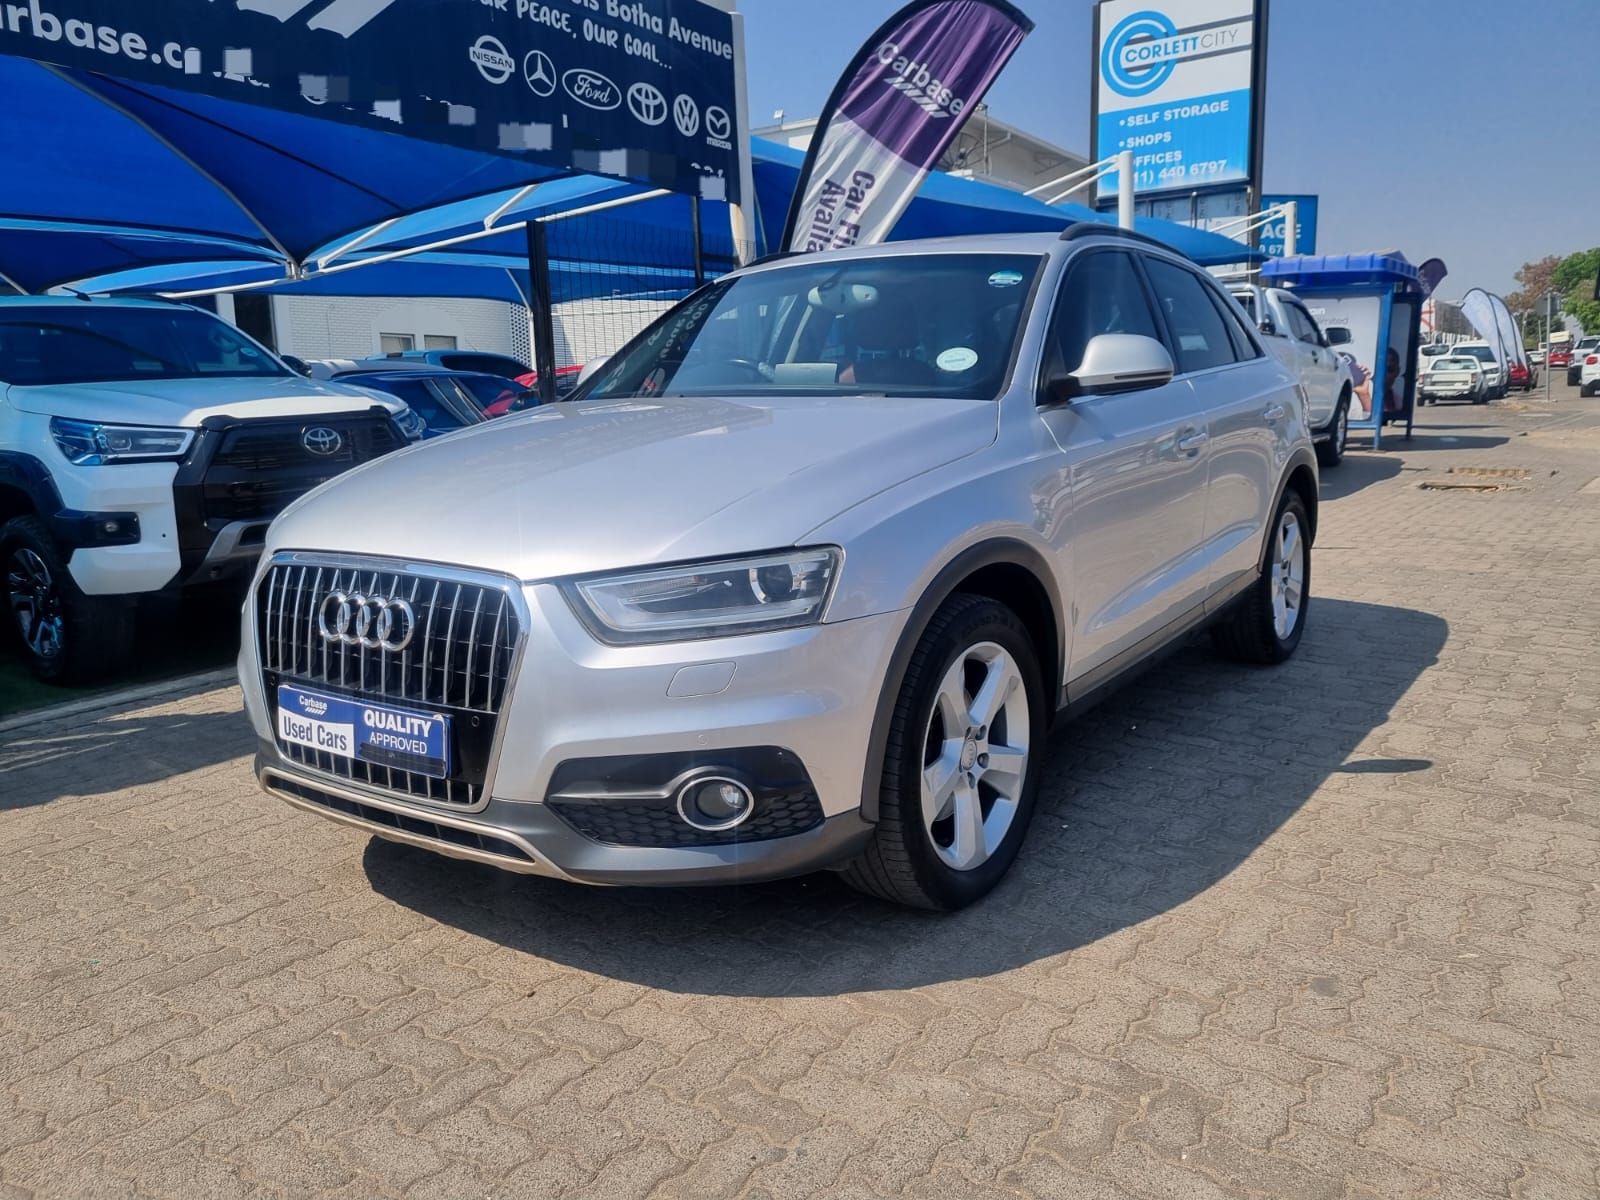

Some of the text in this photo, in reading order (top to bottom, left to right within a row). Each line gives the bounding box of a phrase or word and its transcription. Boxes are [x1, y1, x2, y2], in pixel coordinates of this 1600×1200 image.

[516, 0, 577, 39] PEACE,
[583, 18, 618, 48] OUR
[606, 0, 733, 60] Botha Avenue
[472, 50, 513, 70] NISSAN
[574, 74, 611, 103] Ford
[877, 42, 965, 115] Carbase
[1127, 100, 1230, 127] SELF STORAGE
[1126, 131, 1172, 148] SHOPS
[1133, 150, 1182, 167] FFICES
[1158, 165, 1186, 179] 440
[1189, 159, 1227, 176] 6797
[845, 170, 875, 215] Car
[806, 179, 846, 252] Availa
[299, 695, 328, 711] Carbase
[283, 716, 347, 751] Used Cars
[363, 709, 432, 737] QUALITY
[369, 731, 428, 755] APPROVED
